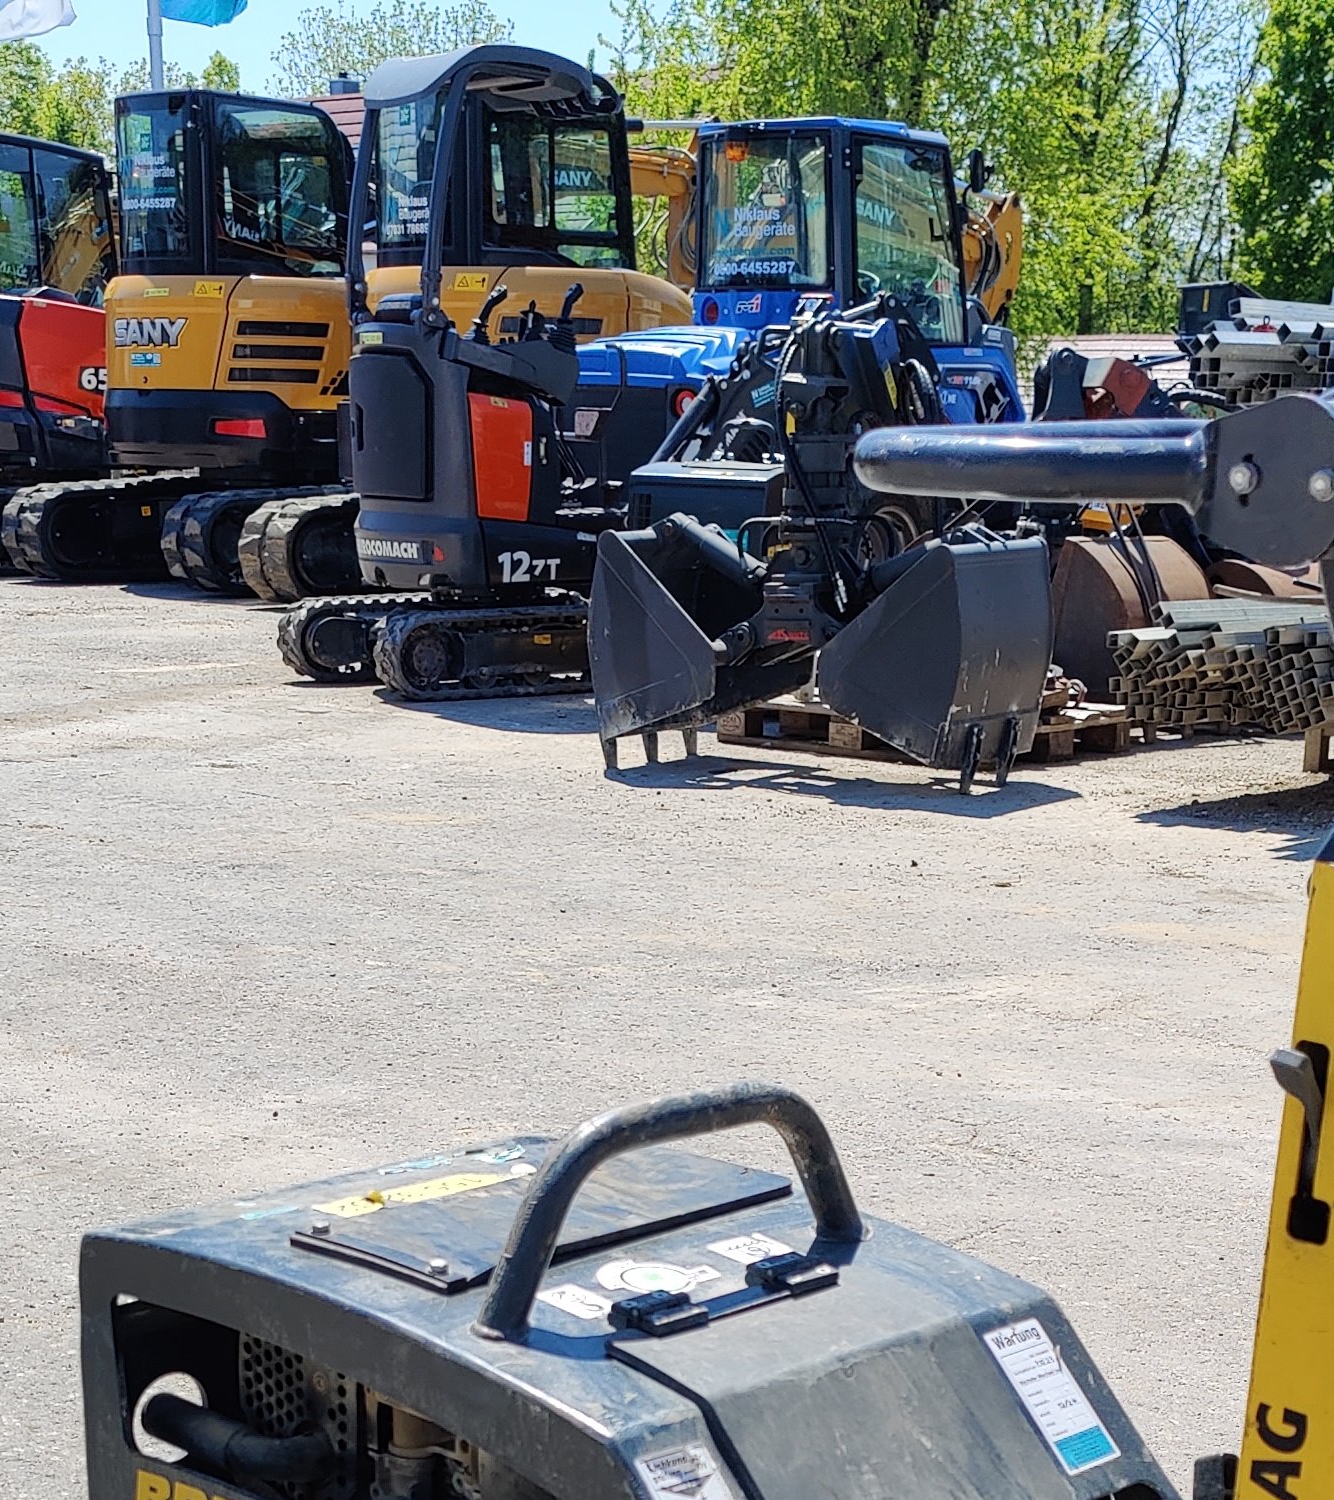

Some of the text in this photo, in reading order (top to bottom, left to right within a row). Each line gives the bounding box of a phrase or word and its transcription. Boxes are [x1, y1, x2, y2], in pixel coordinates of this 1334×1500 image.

[734, 206, 781, 222] Niklaus
[734, 222, 796, 240] Baugeräte
[714, 260, 796, 276] 0800-6455287
[114, 318, 188, 347] SANY
[991, 1326, 1042, 1351] Wartung
